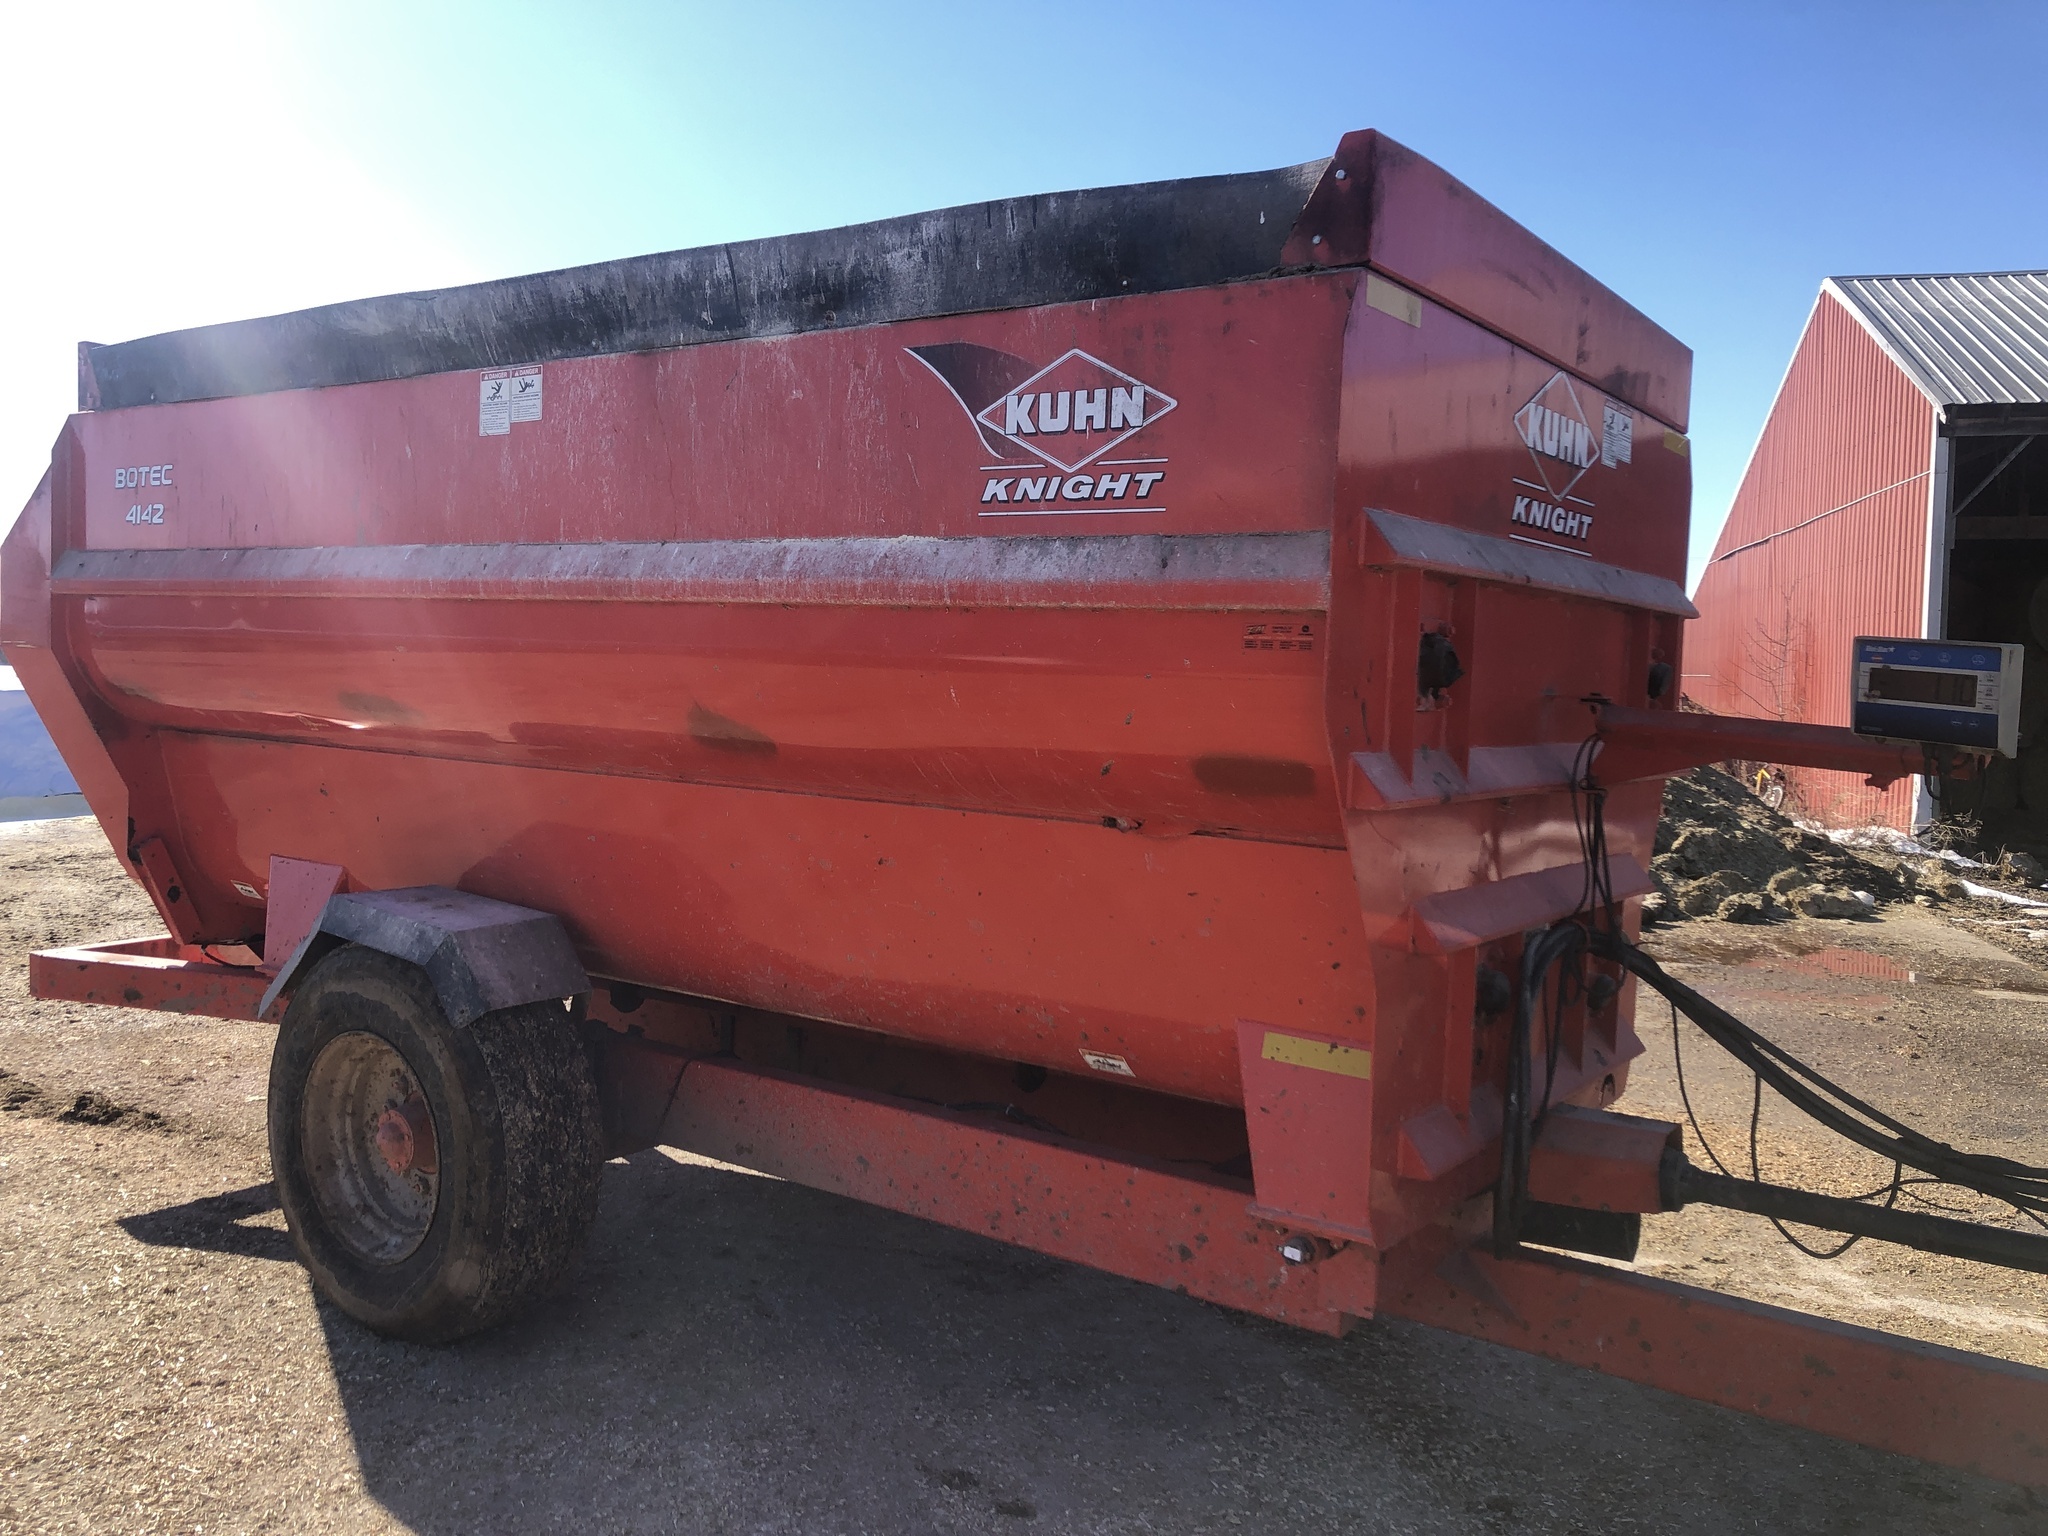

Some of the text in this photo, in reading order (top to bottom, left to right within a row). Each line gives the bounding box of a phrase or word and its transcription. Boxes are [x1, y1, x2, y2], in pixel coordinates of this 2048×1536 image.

[488, 371, 508, 380] DANGER
[519, 367, 539, 376] DANGER
[1005, 385, 1145, 435] KUHN
[1526, 402, 1590, 469] KUHN
[115, 464, 173, 489] BOTEC
[981, 472, 1164, 503] KNIGHT
[125, 503, 164, 525] 4142
[1512, 495, 1593, 540] KNIGHT
